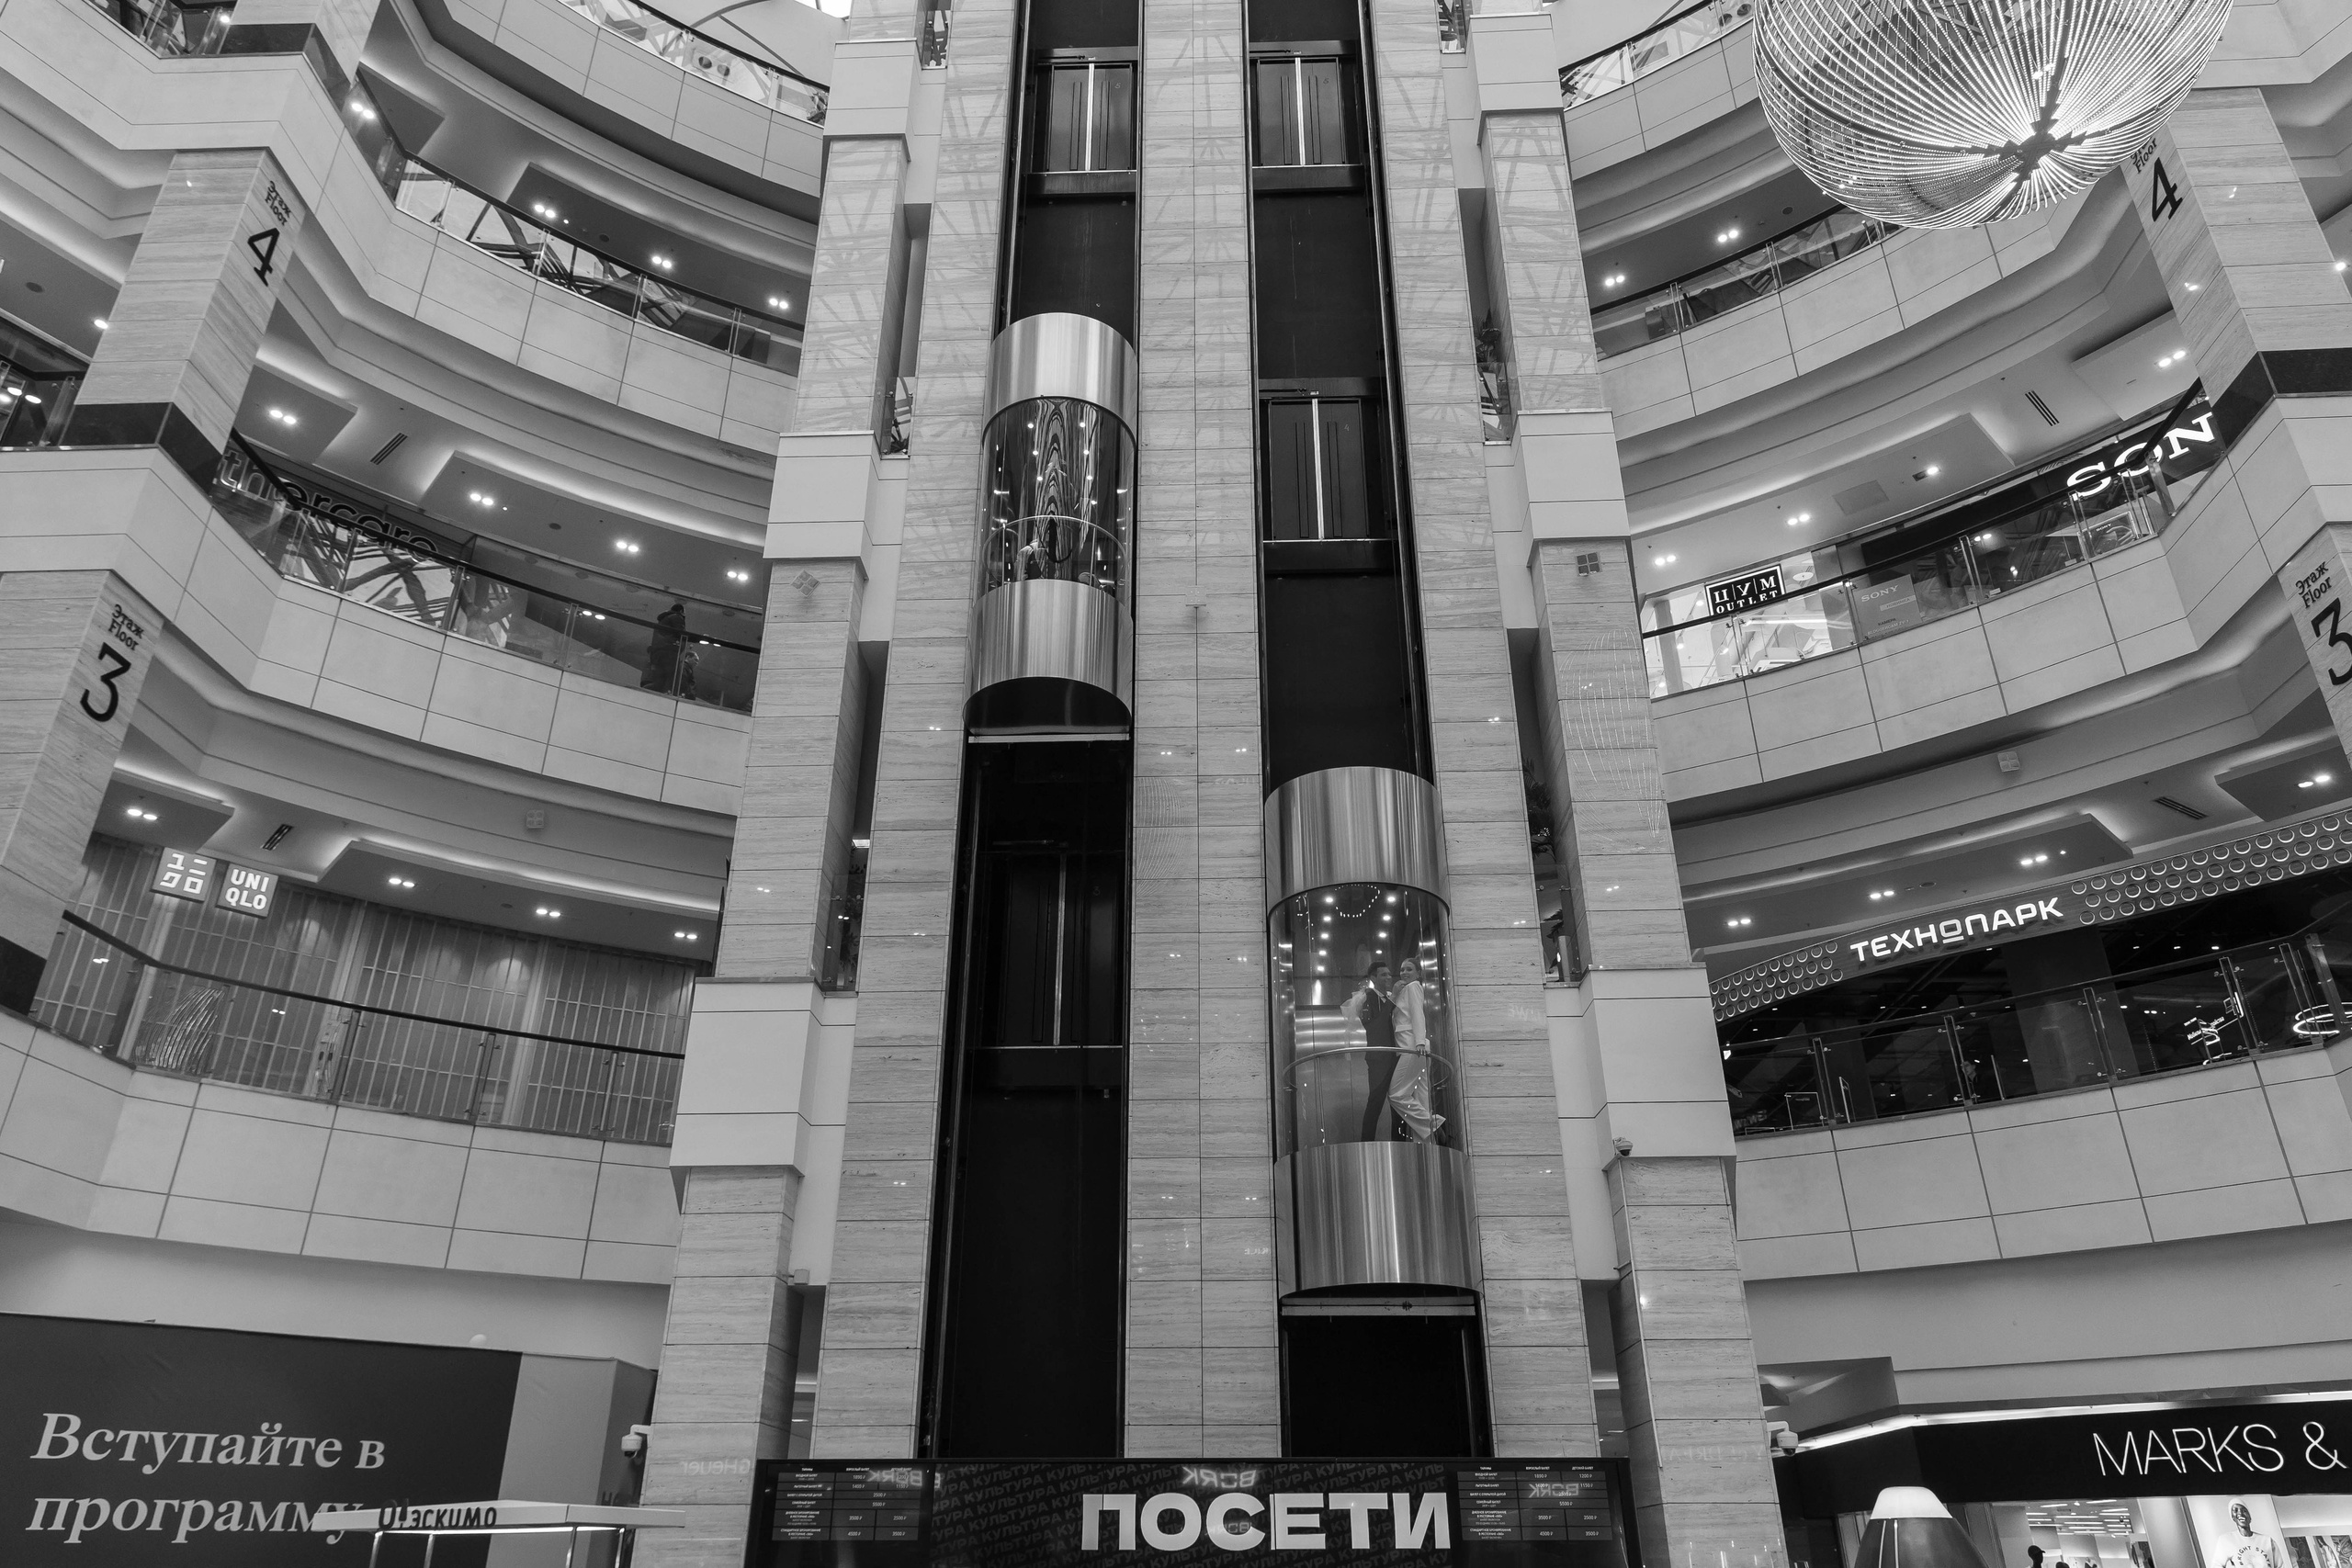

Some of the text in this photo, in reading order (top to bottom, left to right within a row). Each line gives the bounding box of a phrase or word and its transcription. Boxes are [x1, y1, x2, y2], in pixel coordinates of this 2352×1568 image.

[2135, 138, 2157, 174] Floor
[267, 180, 292, 219] Этаж
[2152, 157, 2184, 222] 4
[265, 191, 288, 226] Floor
[247, 228, 280, 287] 4
[1861, 585, 1899, 603] SONY
[2295, 561, 2329, 595] Этаж
[2302, 577, 2333, 609] Floor
[1716, 590, 1779, 614] OUTLET
[107, 618, 139, 650] Floor
[111, 604, 144, 638] Этаж
[2311, 597, 2352, 685] 3
[80, 642, 131, 722] 3
[225, 887, 267, 910] QLO
[231, 869, 270, 893] UNI
[1849, 897, 2064, 962] ТЕХНОПАРК
[30, 1413, 386, 1474] Вступайте в
[2093, 1421, 2348, 1476] MARKS &
[1081, 1492, 1451, 1551] ПОСЕТИ
